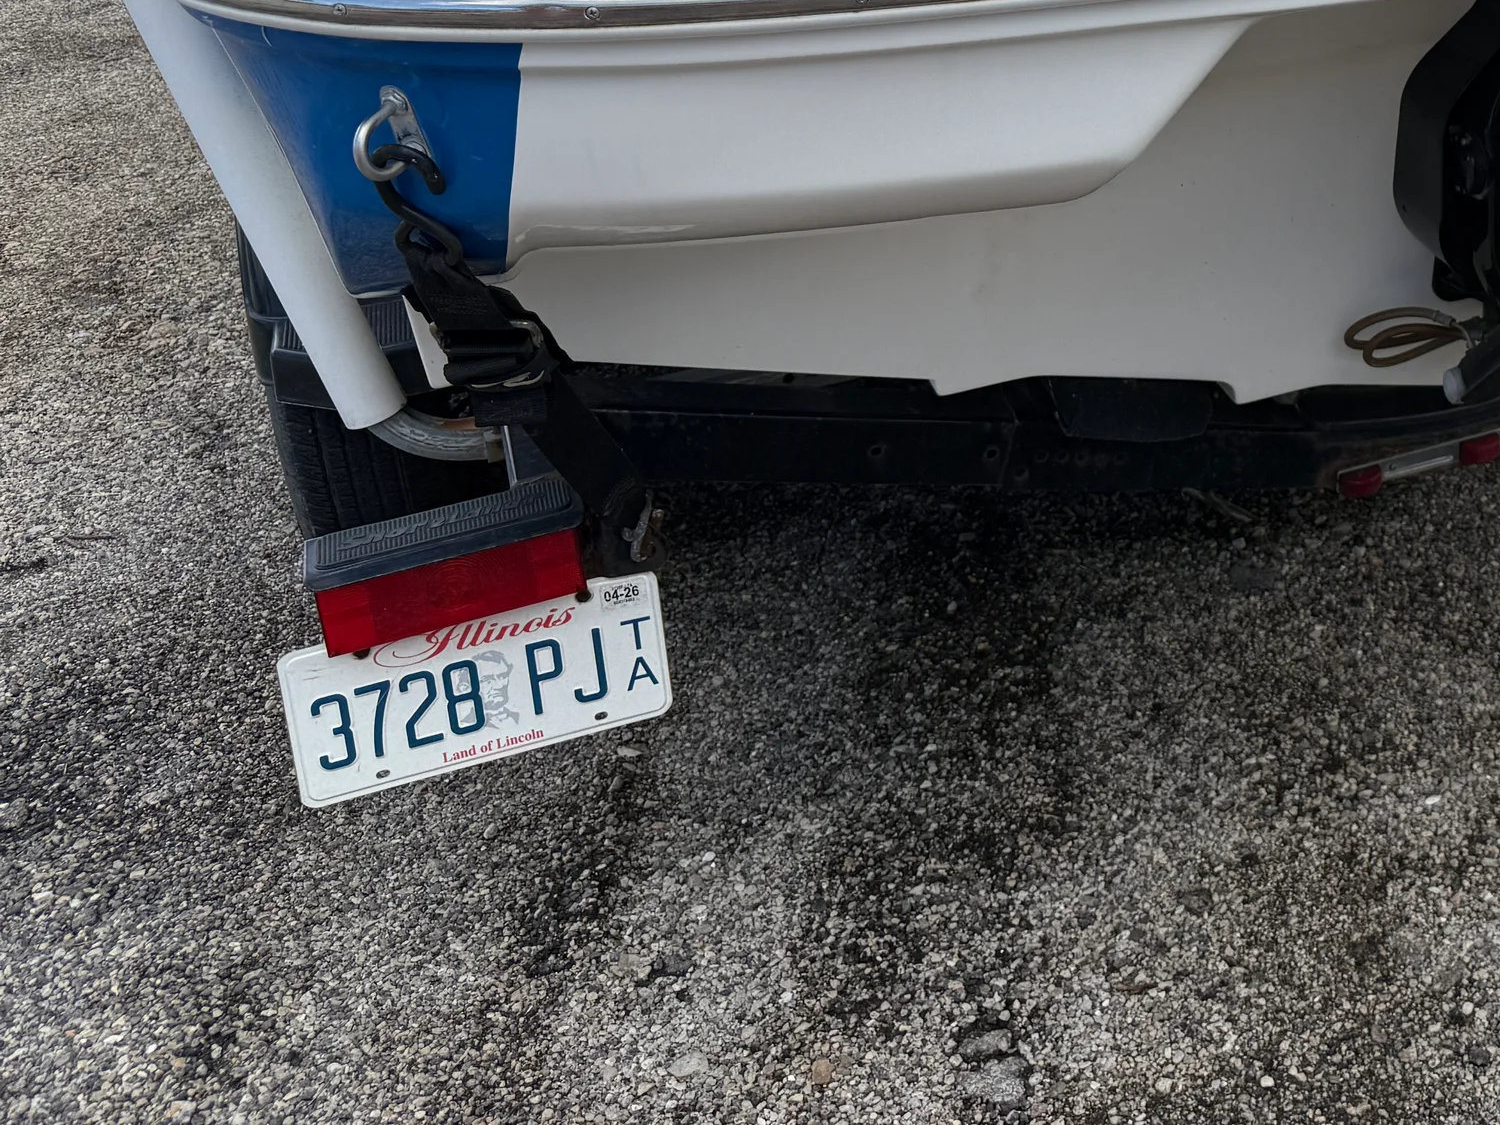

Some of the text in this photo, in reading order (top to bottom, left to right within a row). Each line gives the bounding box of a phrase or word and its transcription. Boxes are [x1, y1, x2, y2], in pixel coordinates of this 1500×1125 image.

[604, 586, 639, 602] 04-26
[374, 606, 575, 667] Illinois
[310, 660, 485, 770] 3728
[525, 628, 608, 715] PJ
[442, 728, 544, 764] Land of Lincoln
